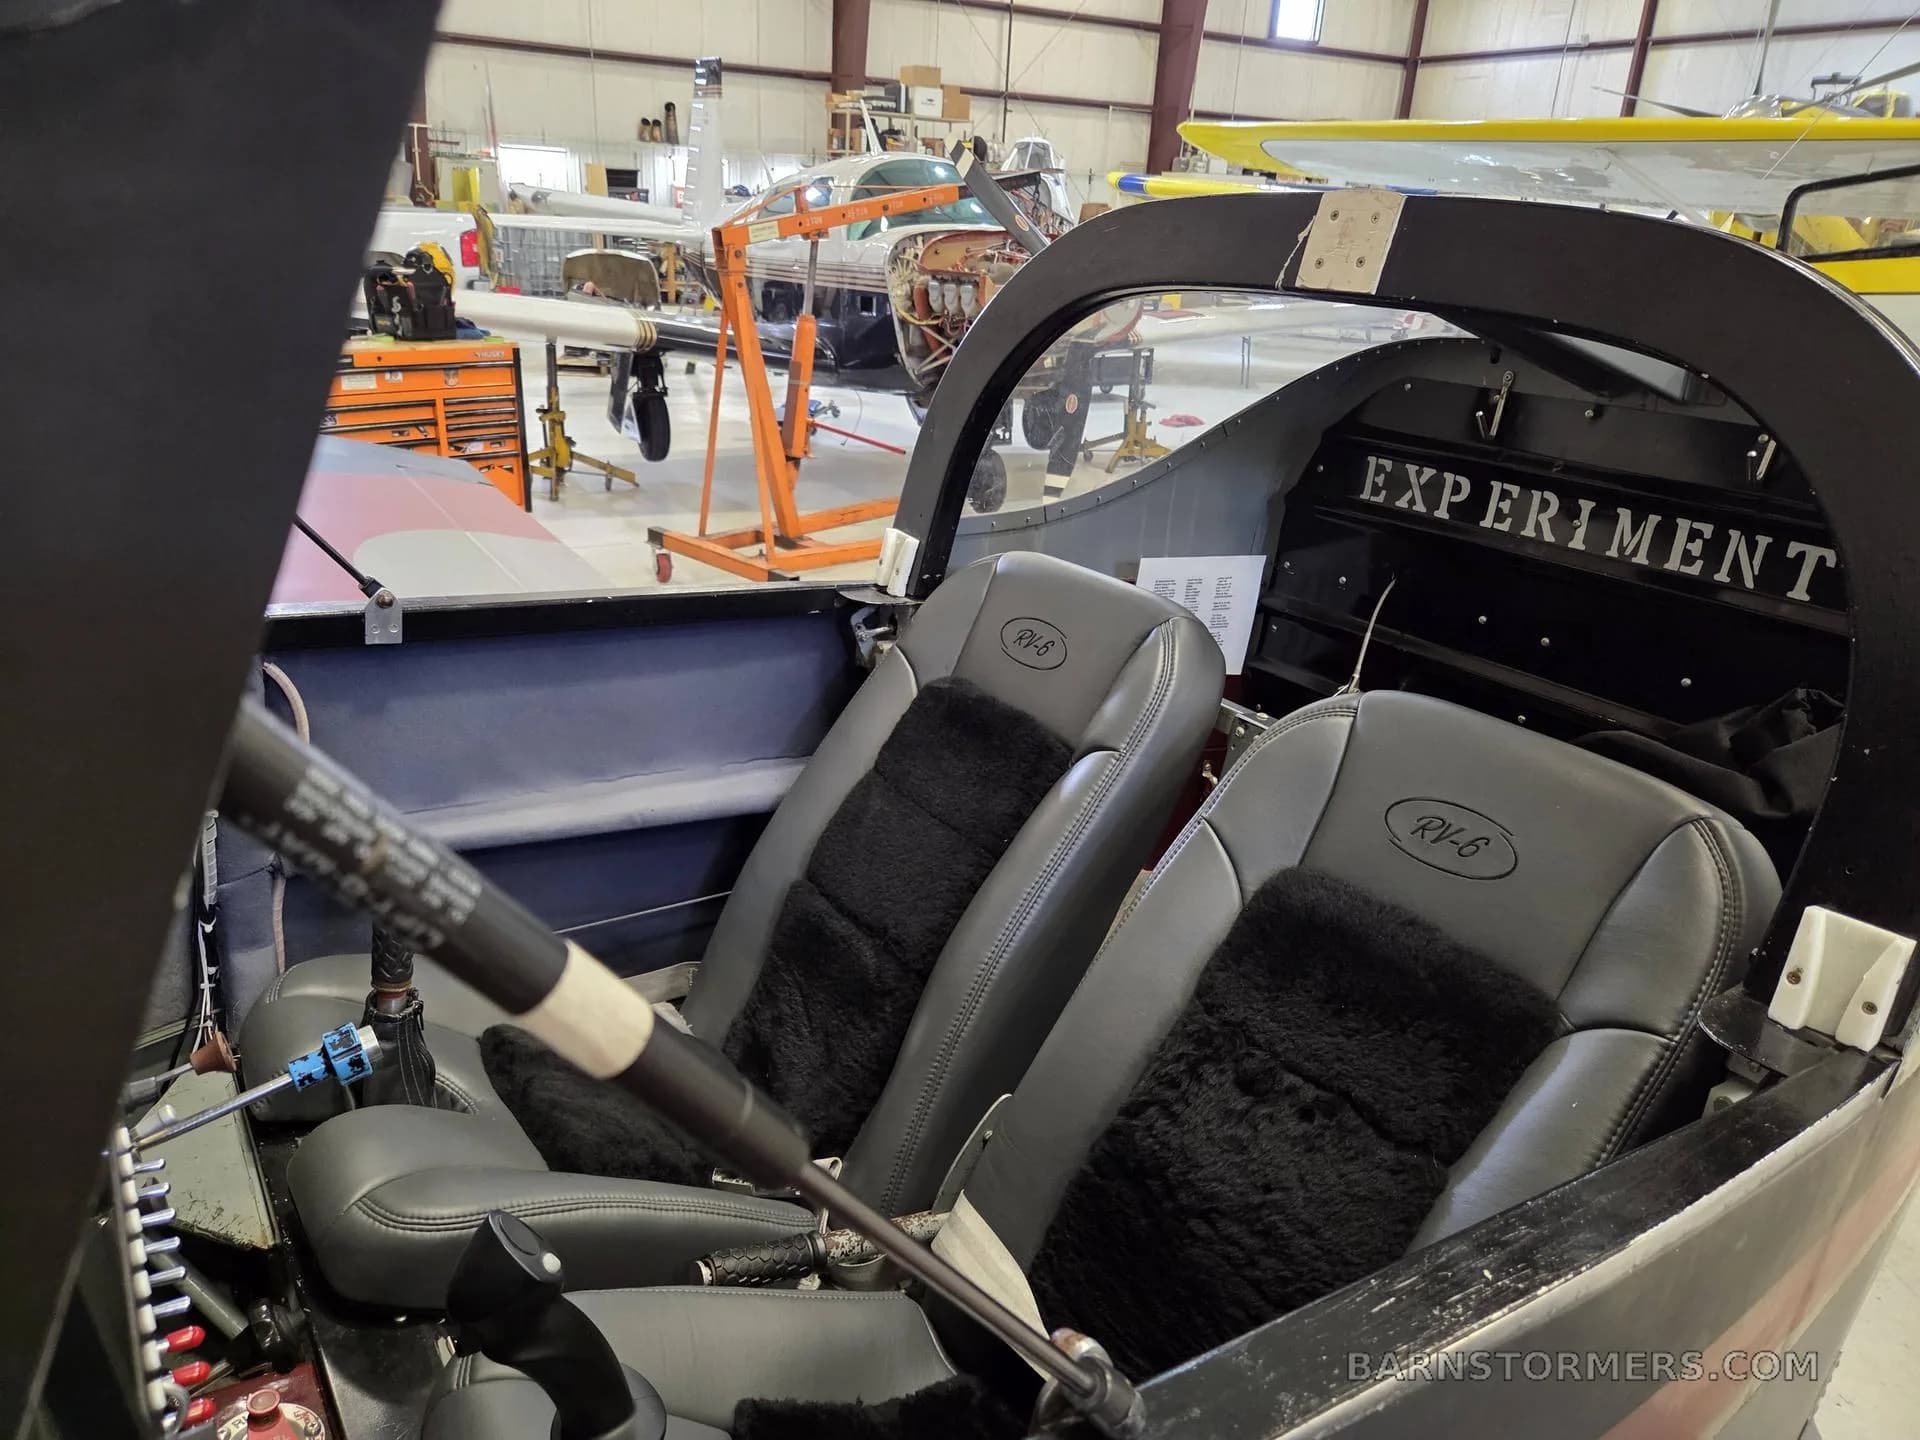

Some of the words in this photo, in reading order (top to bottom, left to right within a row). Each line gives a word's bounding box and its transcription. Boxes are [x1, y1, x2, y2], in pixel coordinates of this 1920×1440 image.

[1359, 455, 1838, 602] EXPERIMENT
[1013, 628, 1056, 657] RV-6
[1410, 815, 1491, 858] RV-6
